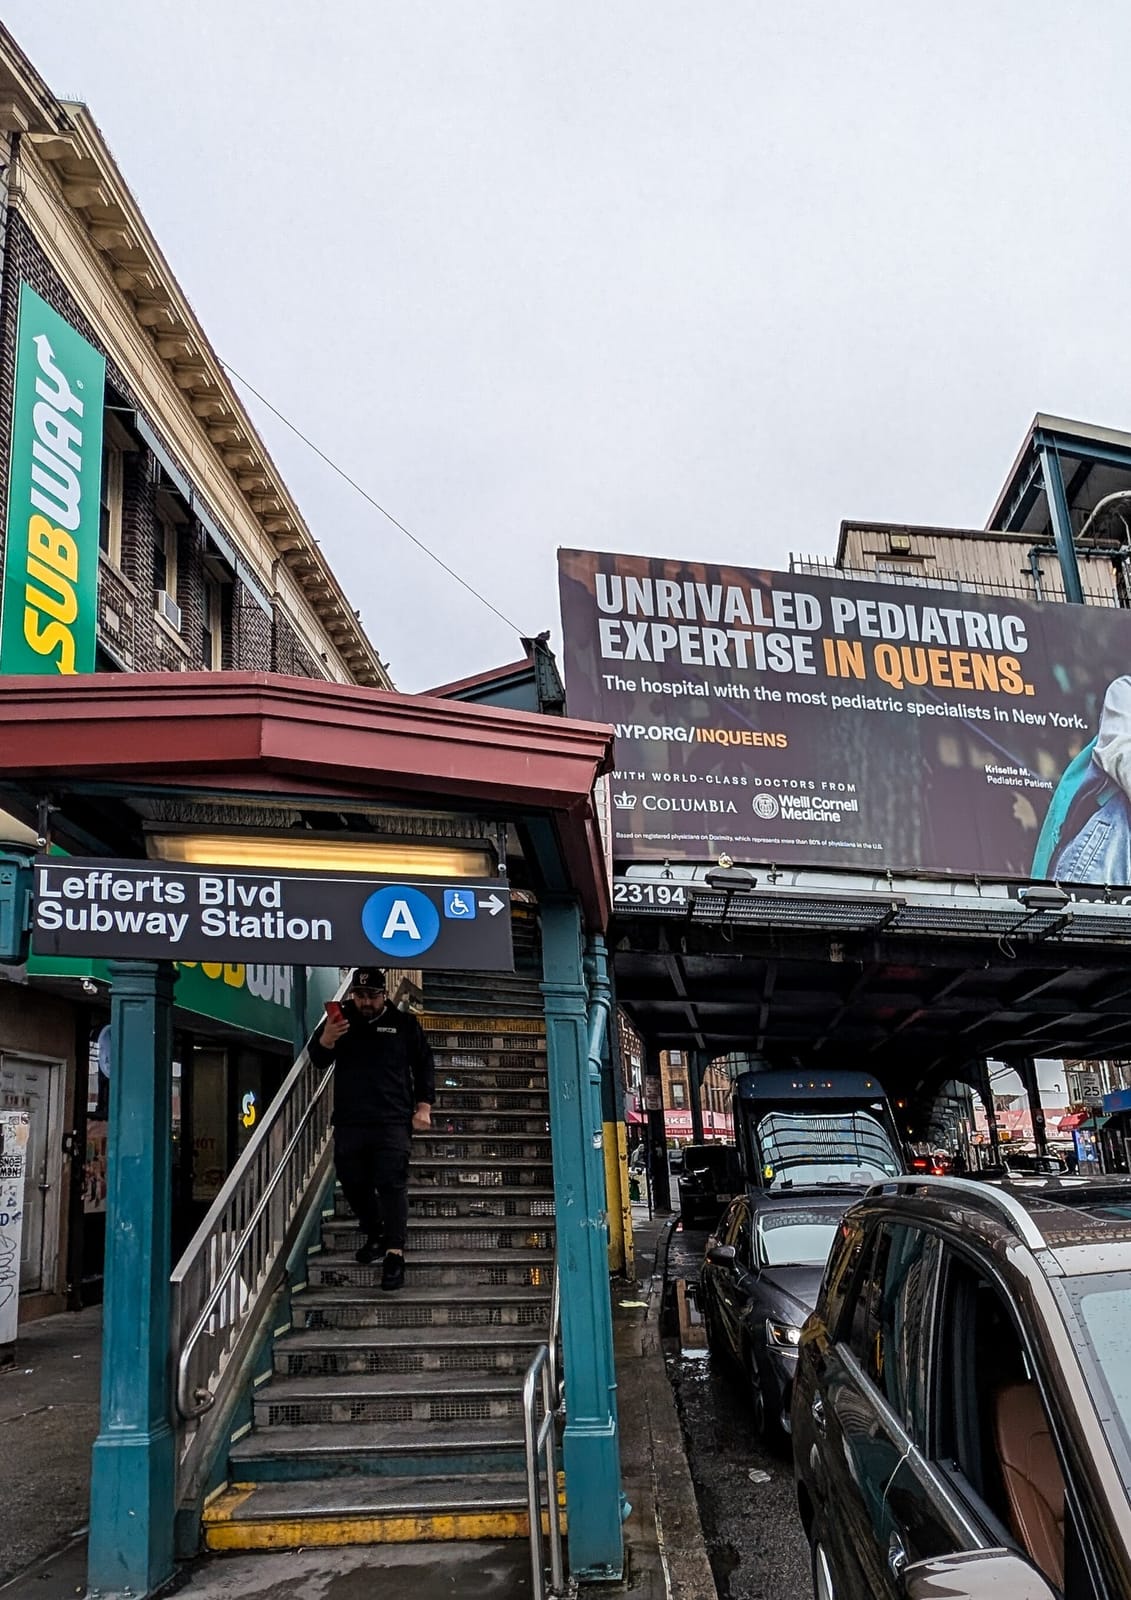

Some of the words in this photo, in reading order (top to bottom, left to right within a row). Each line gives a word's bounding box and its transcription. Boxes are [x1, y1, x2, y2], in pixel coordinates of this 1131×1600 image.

[24, 334, 84, 675] SUBWAY
[595, 573, 822, 631] UNRIVALED
[830, 596, 1028, 653] PEDIATRIC
[598, 618, 817, 675] EXPERTISE
[823, 638, 866, 680] IN
[874, 643, 1035, 696] QUEENS.
[602, 674, 636, 691] The
[640, 677, 709, 697] hospital
[713, 682, 750, 700] with
[754, 685, 781, 702] the
[786, 690, 827, 706] most
[832, 692, 903, 711] pediatric
[907, 701, 991, 720] specialists
[994, 708, 1009, 722] in
[1012, 709, 1046, 725] New
[1049, 712, 1089, 729] York.
[614, 723, 788, 748] NYP.ORG/INQUEENS
[612, 771, 646, 781] WITH
[652, 772, 748, 786] WORLD-CLASS
[754, 778, 816, 790] DOCTORS
[821, 782, 857, 793] FROM
[987, 775, 1023, 786] Pediatric
[1024, 778, 1053, 789] Patient
[1019, 768, 1030, 776] M.
[642, 795, 738, 814] COLUMBIA
[778, 794, 811, 809] Weill
[811, 796, 858, 812] Cornell
[781, 807, 841, 822] Medicine
[671, 833, 699, 841] physicians
[828, 840, 856, 848] physicians
[38, 869, 186, 905] Lefferts
[199, 877, 282, 909] Blvd
[614, 884, 686, 905] 23194
[37, 901, 189, 942] Subway
[200, 909, 333, 942] Station
[381, 900, 421, 940] A
[1083, 1086, 1100, 1096] 25
